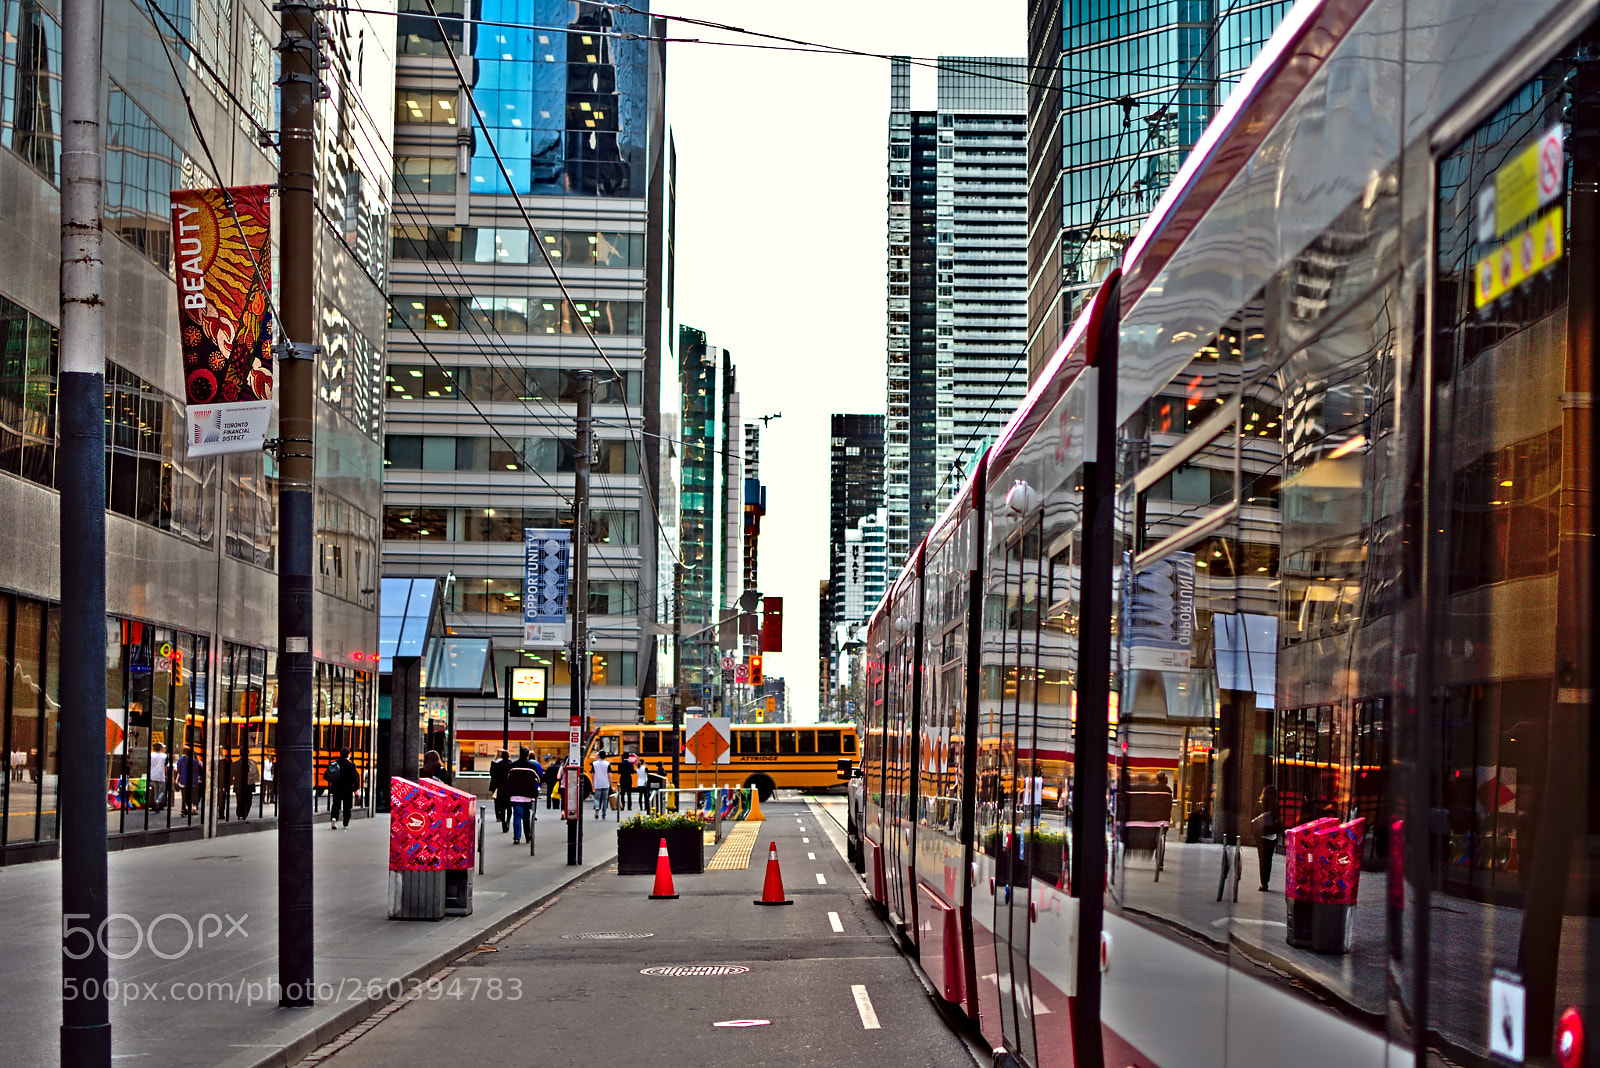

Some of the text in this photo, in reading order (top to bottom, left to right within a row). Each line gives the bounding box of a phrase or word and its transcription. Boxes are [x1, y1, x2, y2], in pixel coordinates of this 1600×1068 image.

[178, 203, 206, 309] BEAUTY
[224, 421, 249, 429] TORONTO
[222, 434, 245, 442] DISTRICT
[527, 534, 539, 618] OPPORTUNITY
[396, 783, 412, 799] P9A
[404, 788, 419, 802] K4A
[391, 795, 402, 807] H9X
